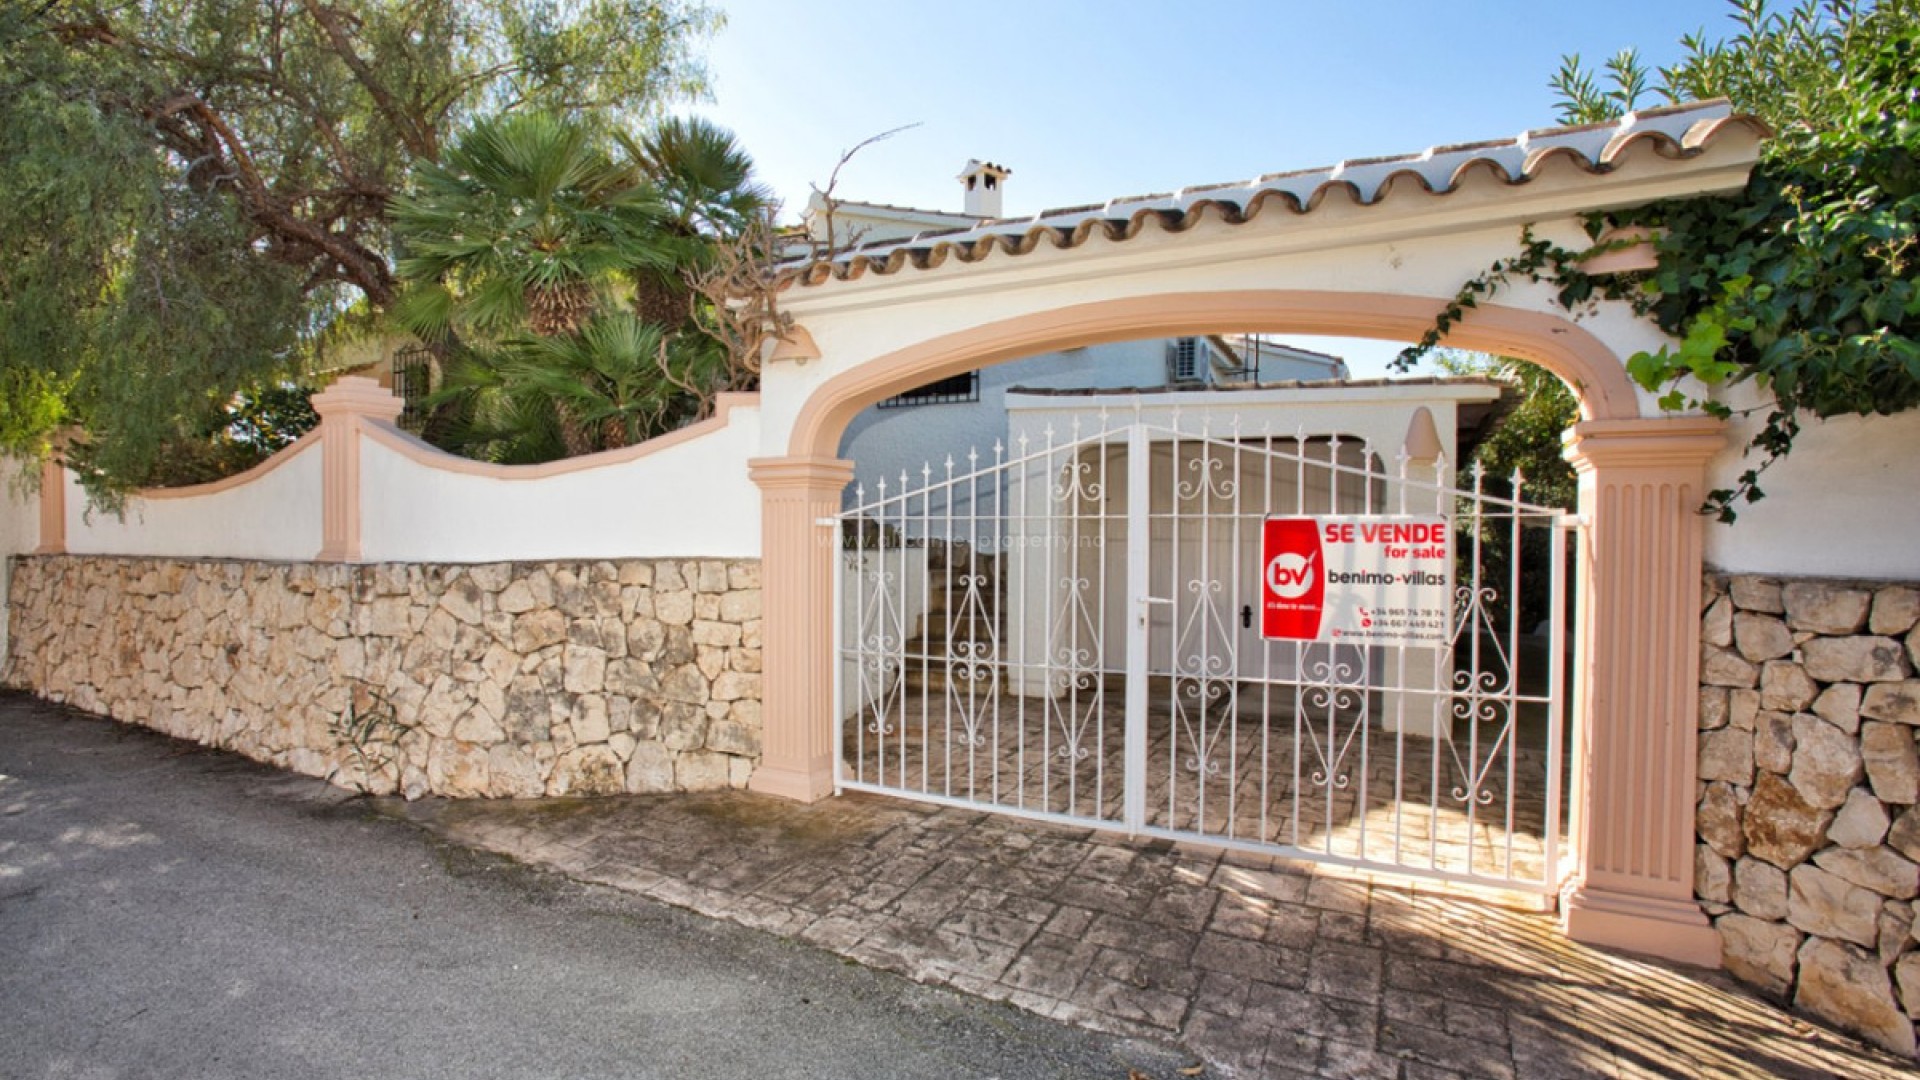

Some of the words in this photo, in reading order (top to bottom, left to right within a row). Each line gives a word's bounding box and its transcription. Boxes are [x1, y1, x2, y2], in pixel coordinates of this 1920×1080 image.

[1325, 523, 1355, 543] SE
[1360, 523, 1446, 543] VENDE
[1384, 545, 1408, 559] for
[1412, 545, 1446, 559] sale
[1274, 561, 1312, 586] bv
[1328, 569, 1446, 586] benimo-villas
